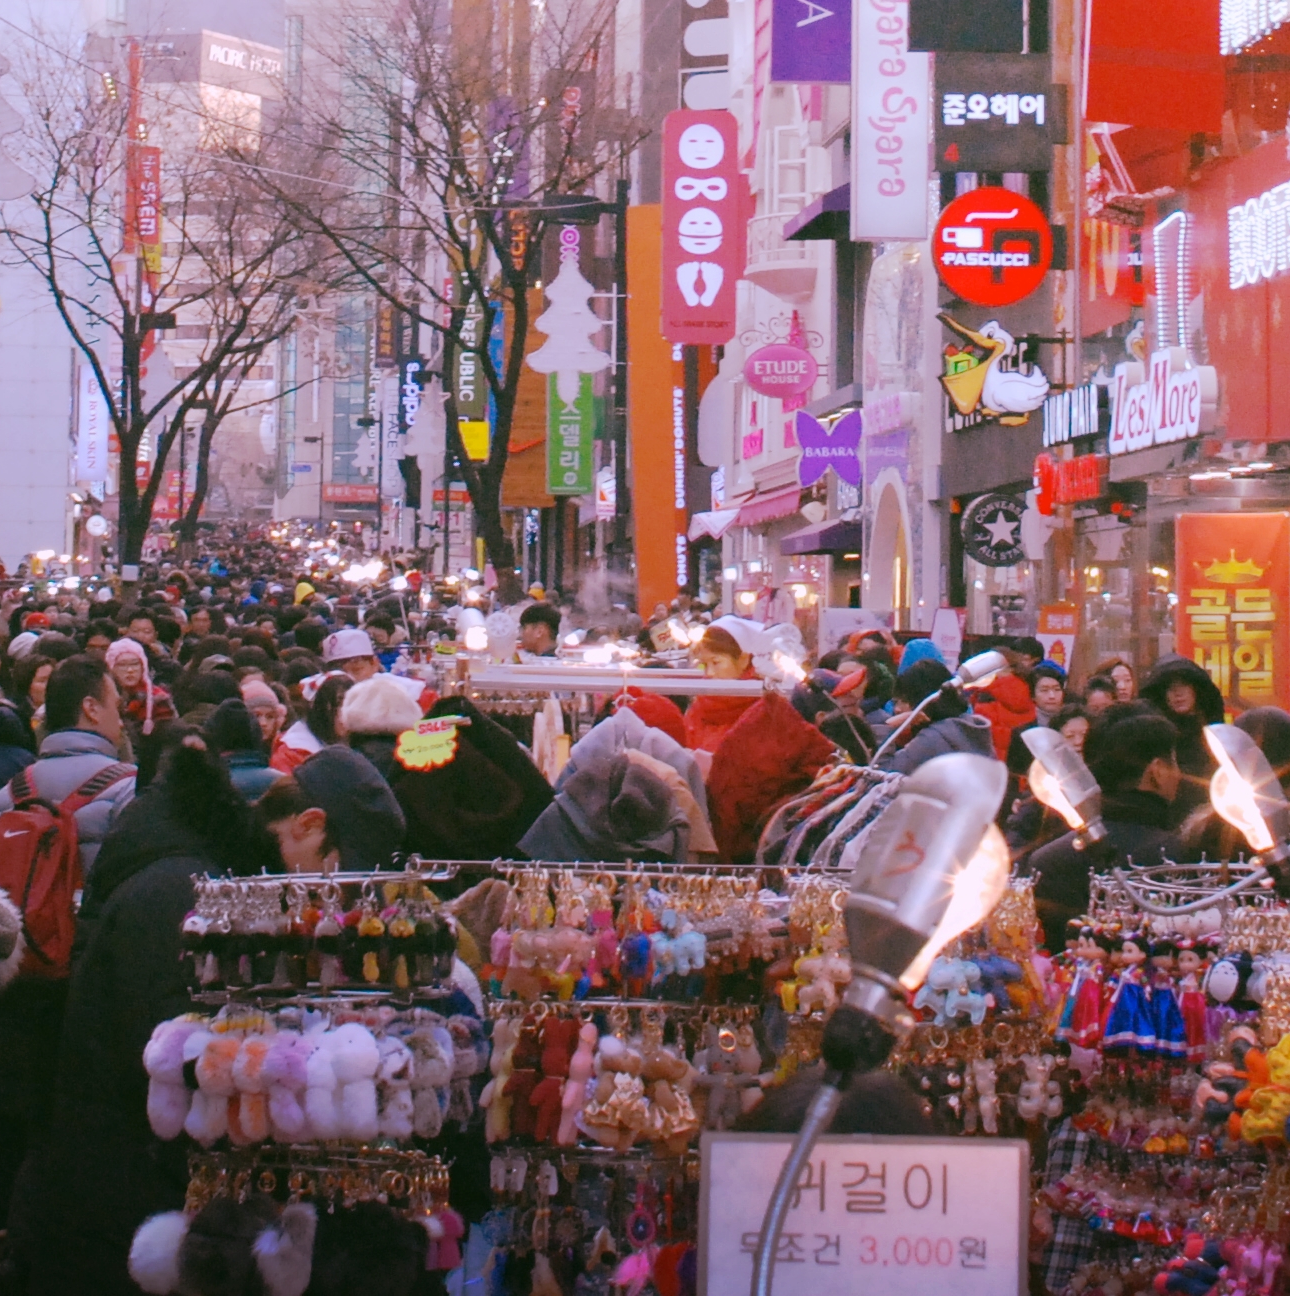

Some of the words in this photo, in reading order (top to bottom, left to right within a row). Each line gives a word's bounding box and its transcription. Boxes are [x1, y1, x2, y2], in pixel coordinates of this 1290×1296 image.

[942, 93, 1046, 125] 준오헤어
[870, 86, 919, 199] Shara
[941, 251, 1030, 267] PASCUCCI
[753, 360, 809, 375] ETUDE
[761, 375, 801, 385] HOUSE
[1112, 373, 1149, 442] Les
[1149, 359, 1200, 437] More
[804, 446, 855, 459] BABARA
[1186, 588, 1276, 641] 골든
